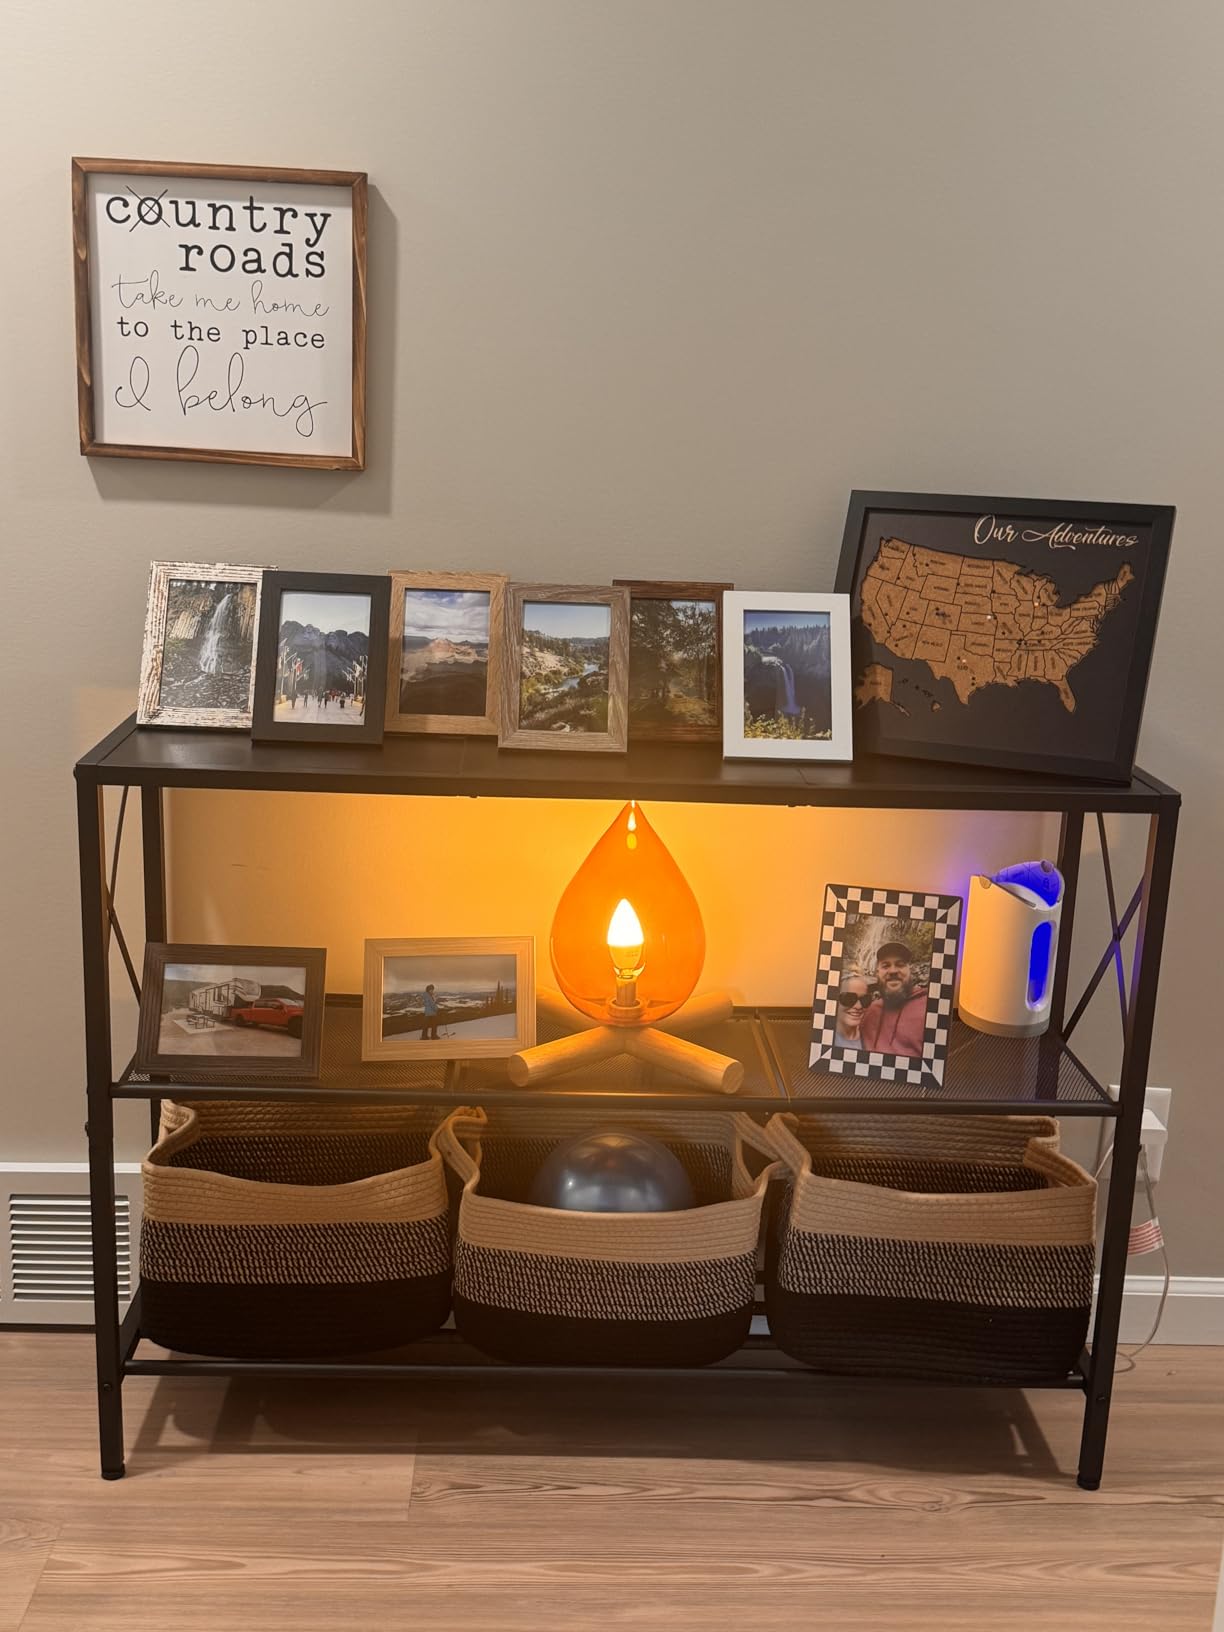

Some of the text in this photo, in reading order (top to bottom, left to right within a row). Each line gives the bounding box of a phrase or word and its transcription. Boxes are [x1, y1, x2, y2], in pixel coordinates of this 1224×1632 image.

[105, 195, 332, 247] country
[178, 243, 326, 278] roads
[111, 269, 330, 317] take me home
[116, 316, 326, 350] to the place
[115, 345, 328, 438] I belong
[974, 514, 1139, 550] Our Adventures
